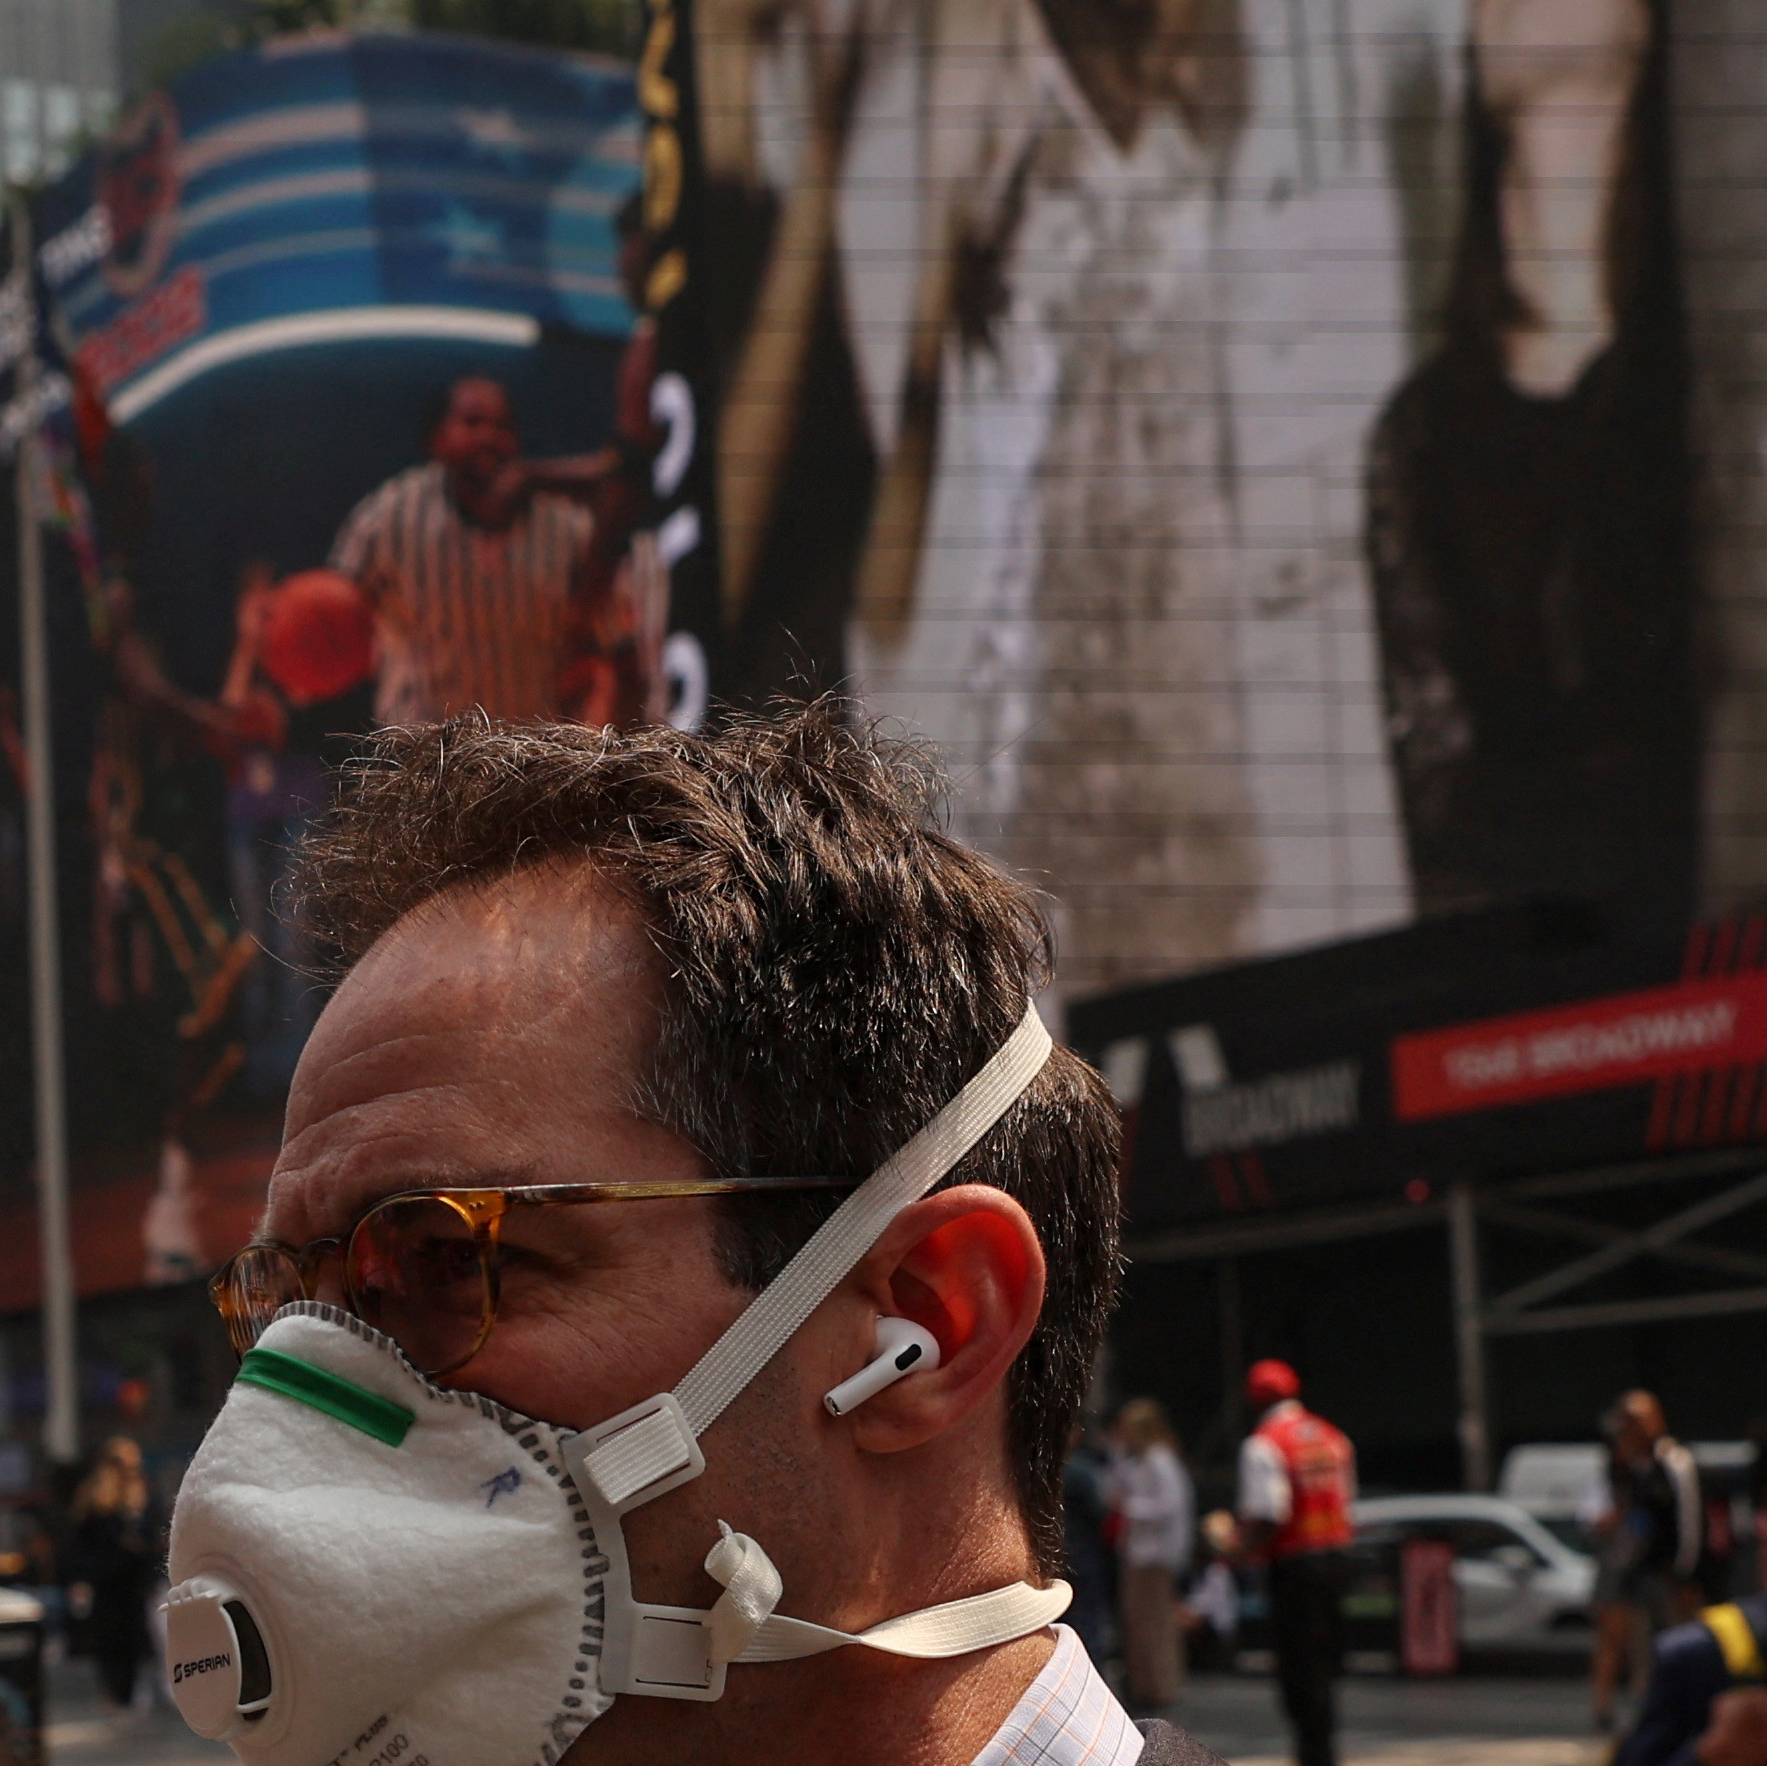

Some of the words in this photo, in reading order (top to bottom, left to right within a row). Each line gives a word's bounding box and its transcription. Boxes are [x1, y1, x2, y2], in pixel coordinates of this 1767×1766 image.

[1529, 1000, 1739, 1082] BROADWAY
[1180, 1058, 1362, 1159] BROADWAY
[183, 1652, 231, 1679] SPERIAN
